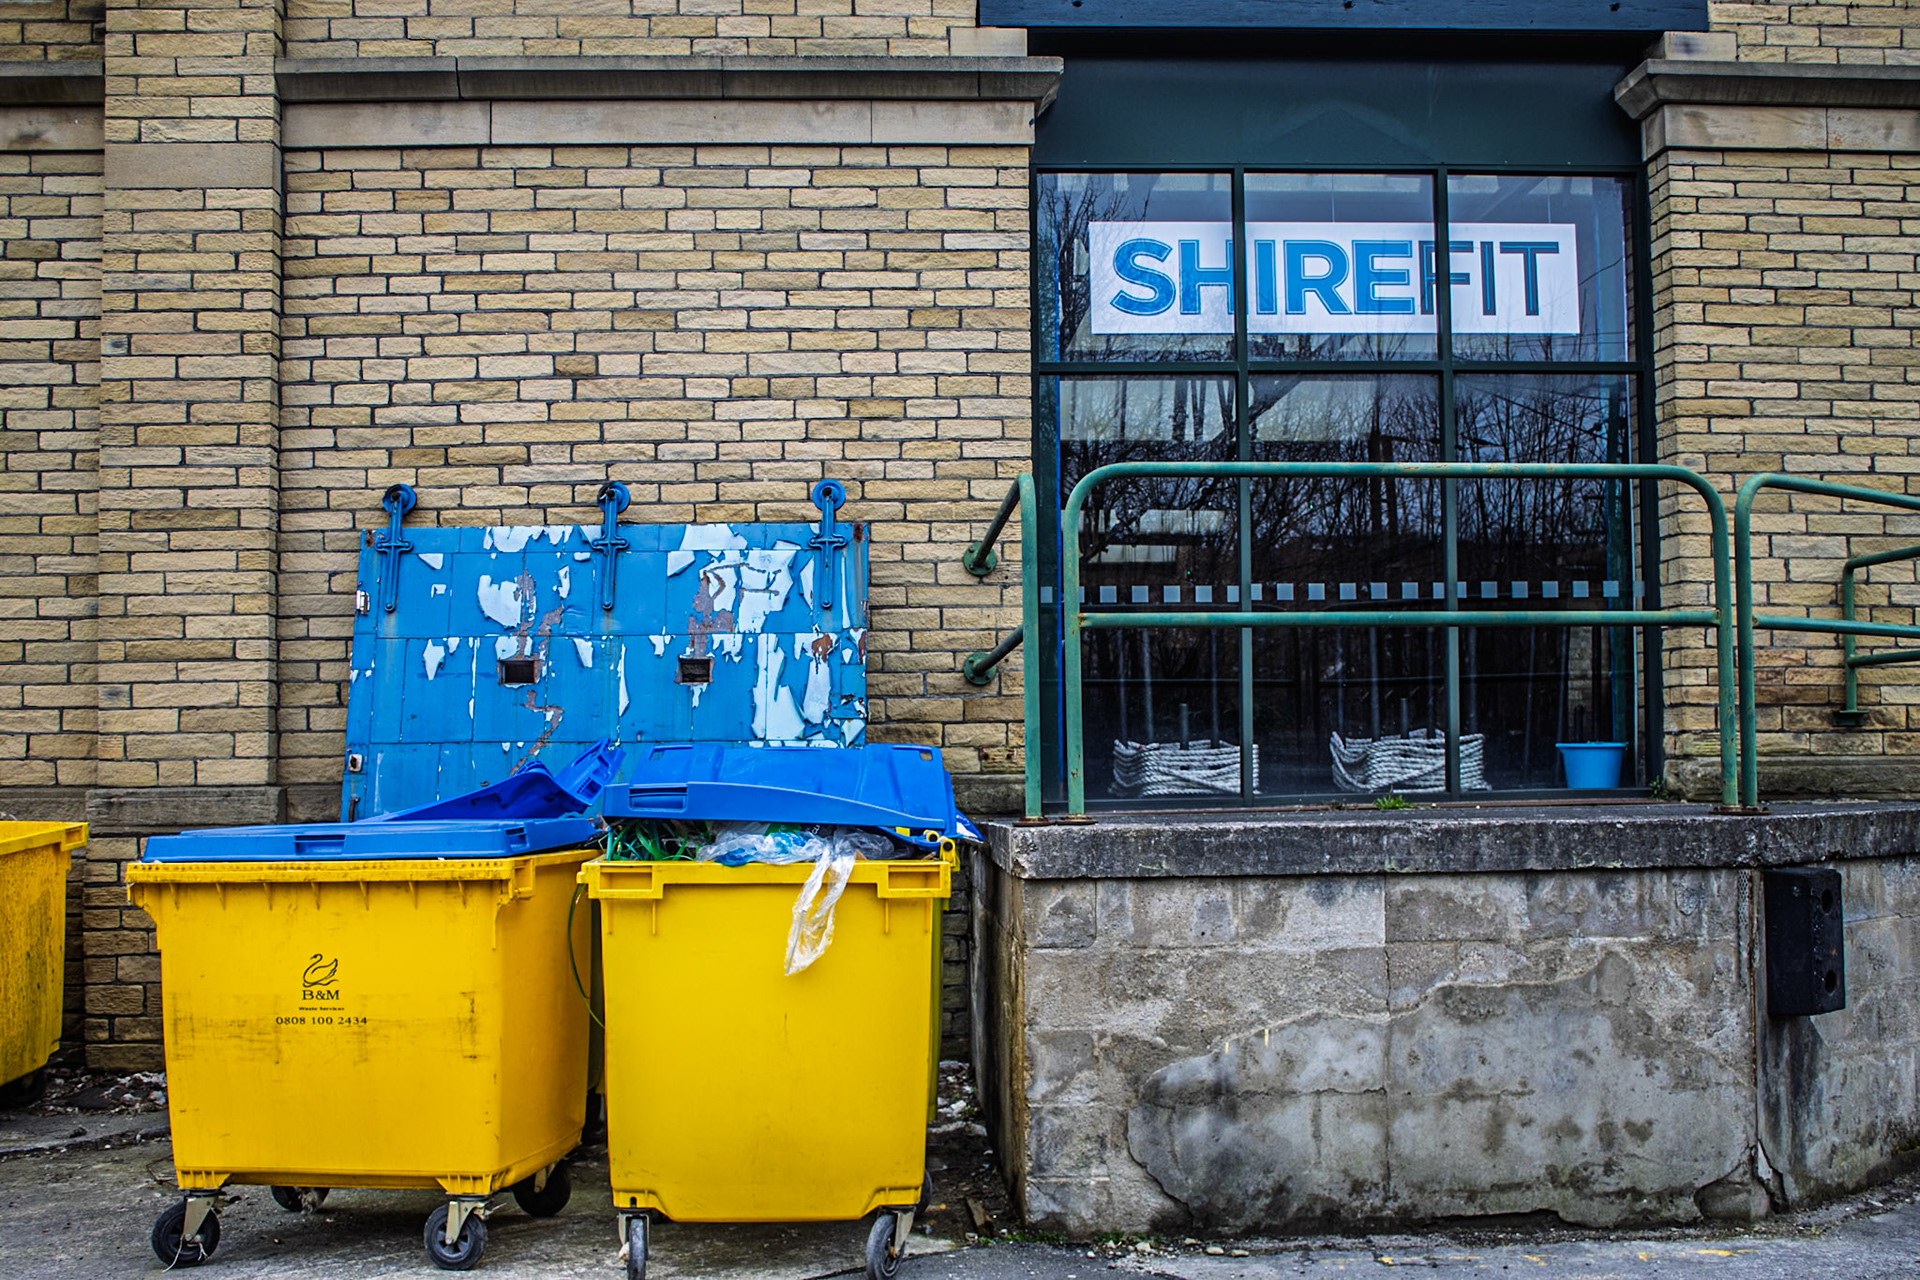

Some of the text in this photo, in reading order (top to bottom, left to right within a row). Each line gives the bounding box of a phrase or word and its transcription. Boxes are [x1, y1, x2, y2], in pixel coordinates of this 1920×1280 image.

[1109, 238, 1559, 316] SHIREFIT
[302, 989, 339, 1000] B&M
[275, 1016, 367, 1025] 0808 100 2434
